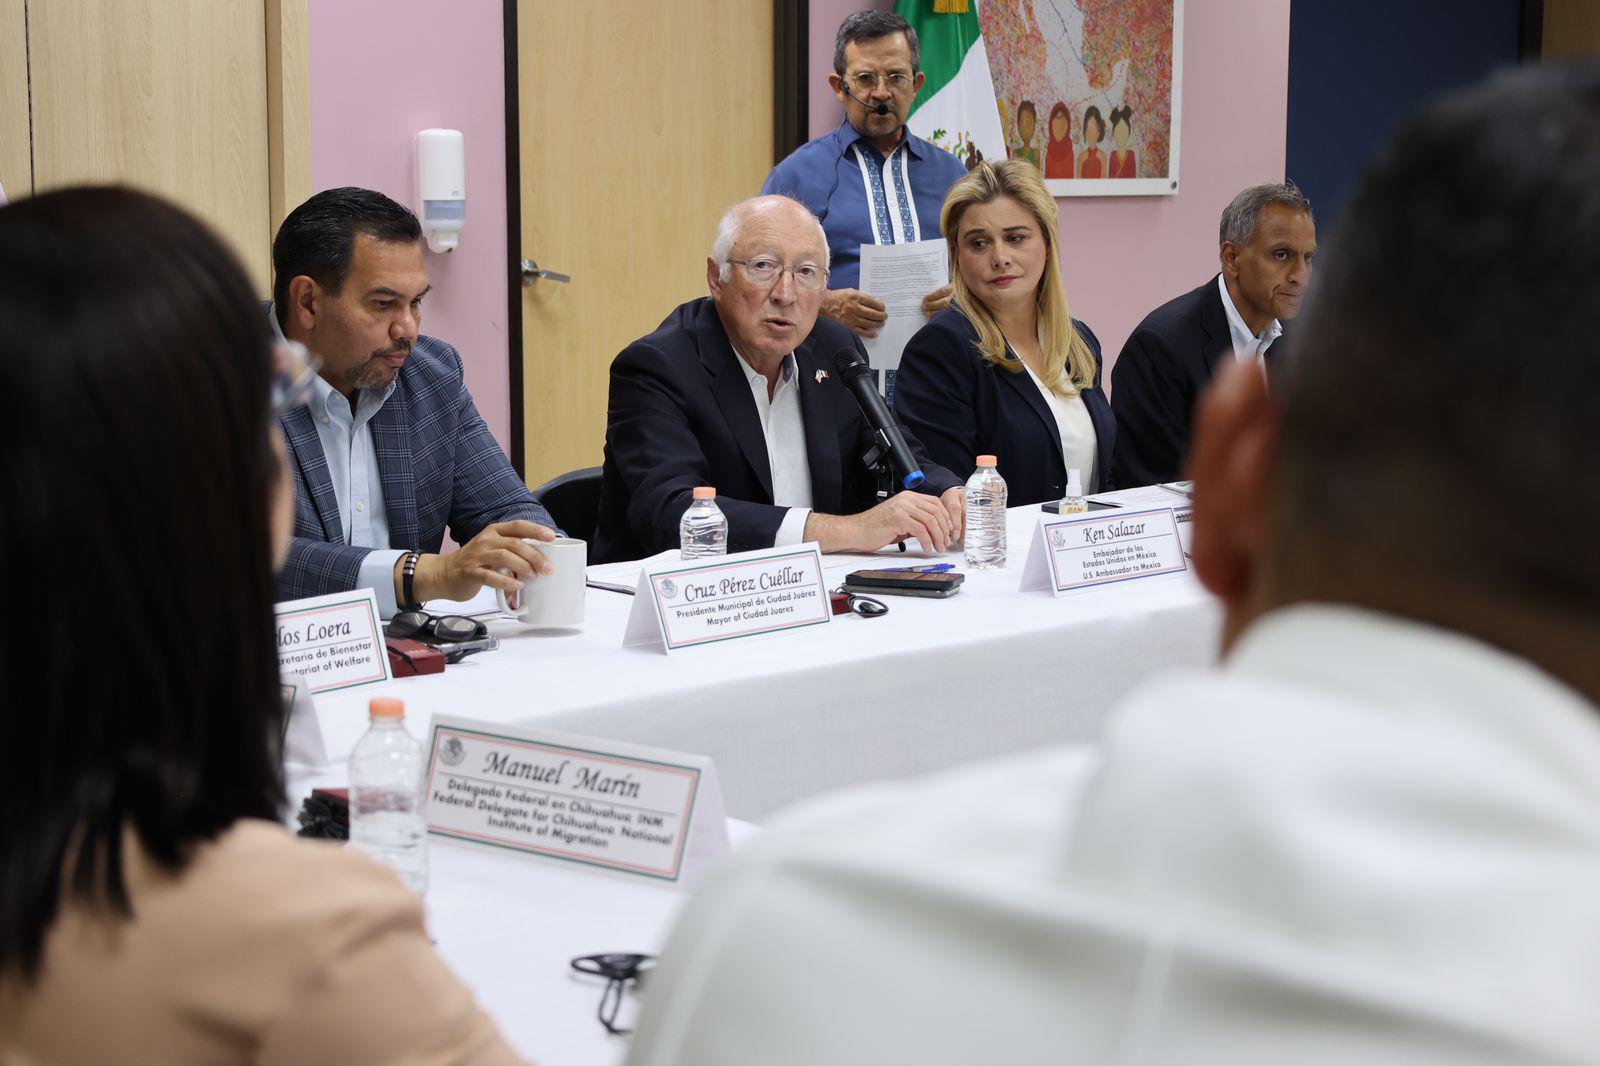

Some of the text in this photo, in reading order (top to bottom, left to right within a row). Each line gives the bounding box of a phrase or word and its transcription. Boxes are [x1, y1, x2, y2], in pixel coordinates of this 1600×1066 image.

[1083, 521, 1146, 544] Ken Salazar
[1082, 559, 1105, 568] Estados
[1106, 556, 1127, 565] Unidos
[1093, 547, 1125, 558] Embajador
[1135, 544, 1144, 552] los
[1096, 565, 1132, 577] Ambassador
[1140, 561, 1162, 570] Mexico
[685, 566, 804, 602] Cruz Pérez Cuéllar
[676, 606, 716, 618] Presidente
[718, 598, 754, 611] Municipal
[756, 596, 765, 605] de
[767, 592, 791, 604] Ciudad
[707, 605, 794, 626] Mayor of Ciudad Juarez
[278, 621, 352, 647] los Loera
[280, 643, 372, 665] retaria de Bienestar
[323, 661, 332, 671] of
[334, 656, 371, 669] Welfare
[482, 751, 641, 798] Manuel Marín
[448, 779, 503, 797] Delegado
[506, 789, 549, 807] Federal
[552, 799, 566, 809] en
[433, 790, 475, 808] Federal
[478, 799, 529, 818] Delegate
[532, 810, 549, 822] for
[621, 826, 674, 846] National
[488, 816, 609, 847] Institute of Migration
